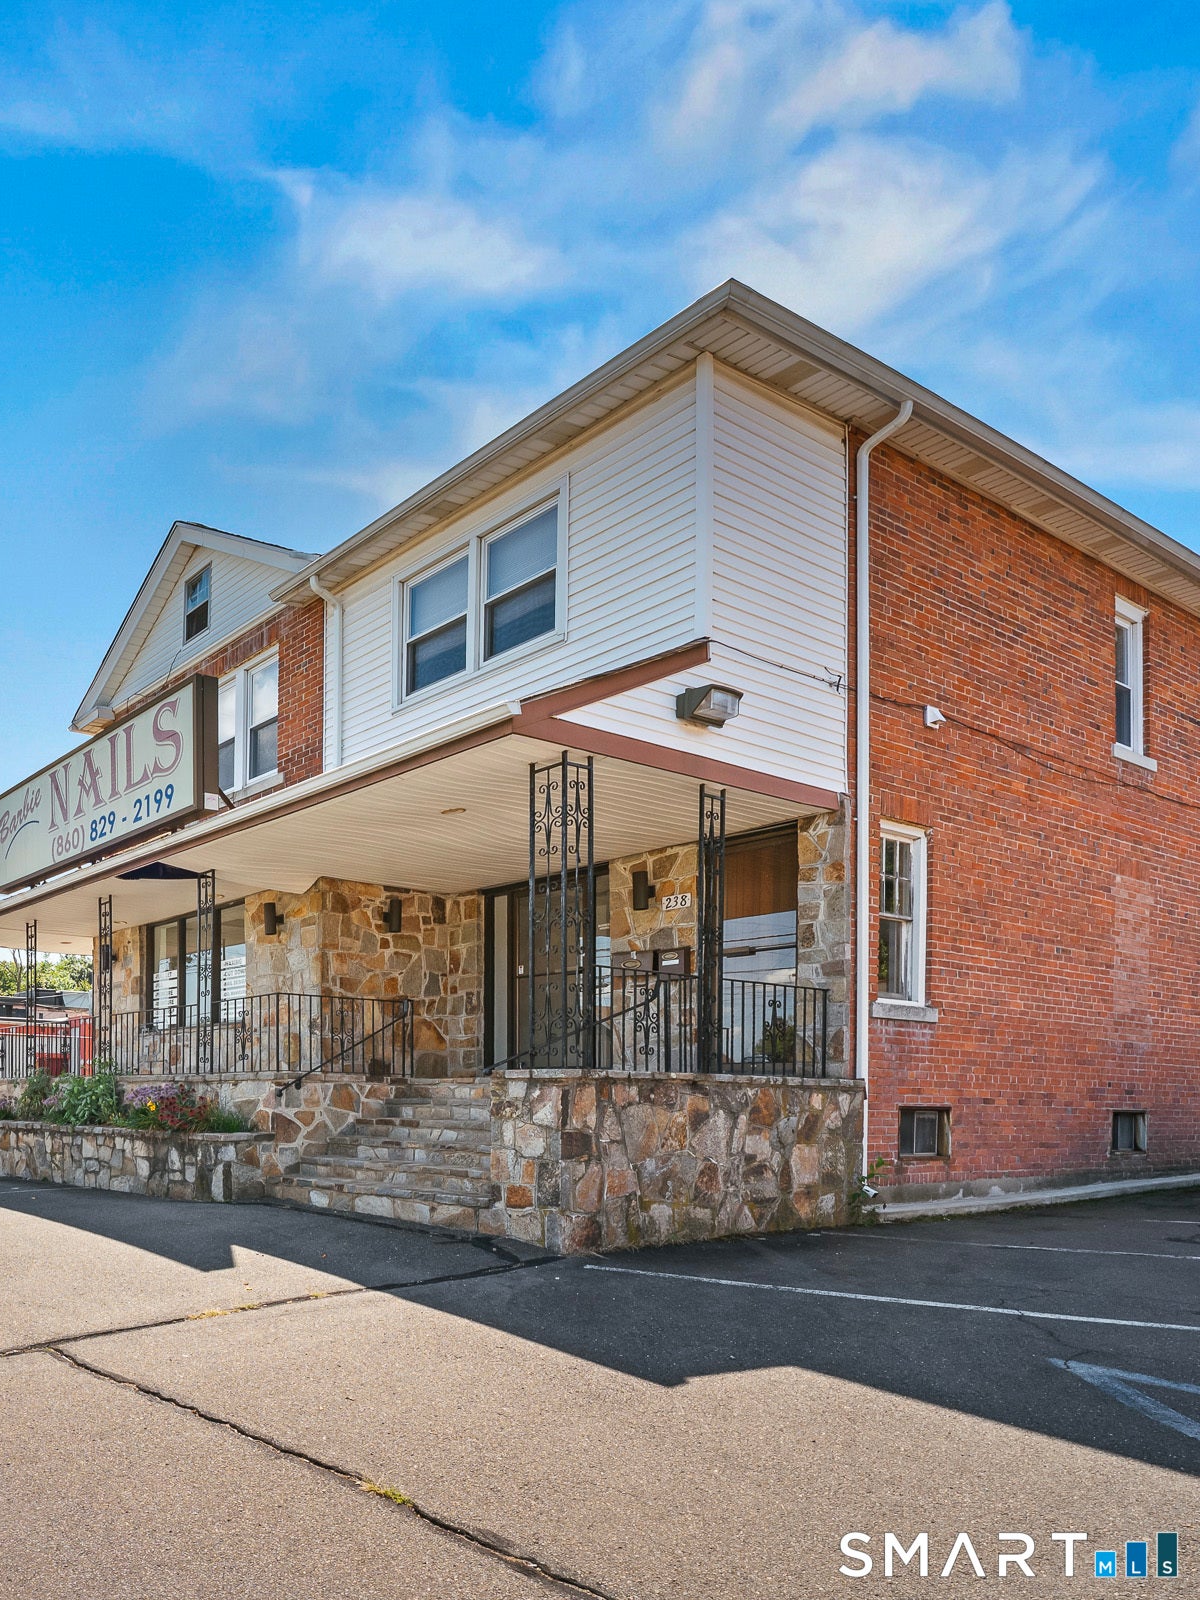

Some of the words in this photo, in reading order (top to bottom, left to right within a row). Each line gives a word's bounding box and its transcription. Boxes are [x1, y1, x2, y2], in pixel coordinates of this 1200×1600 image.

[47, 697, 184, 834] NAILS
[52, 824, 85, 863] (860)
[90, 811, 116, 841] 829
[133, 783, 175, 824] 2199
[666, 894, 688, 909] 238
